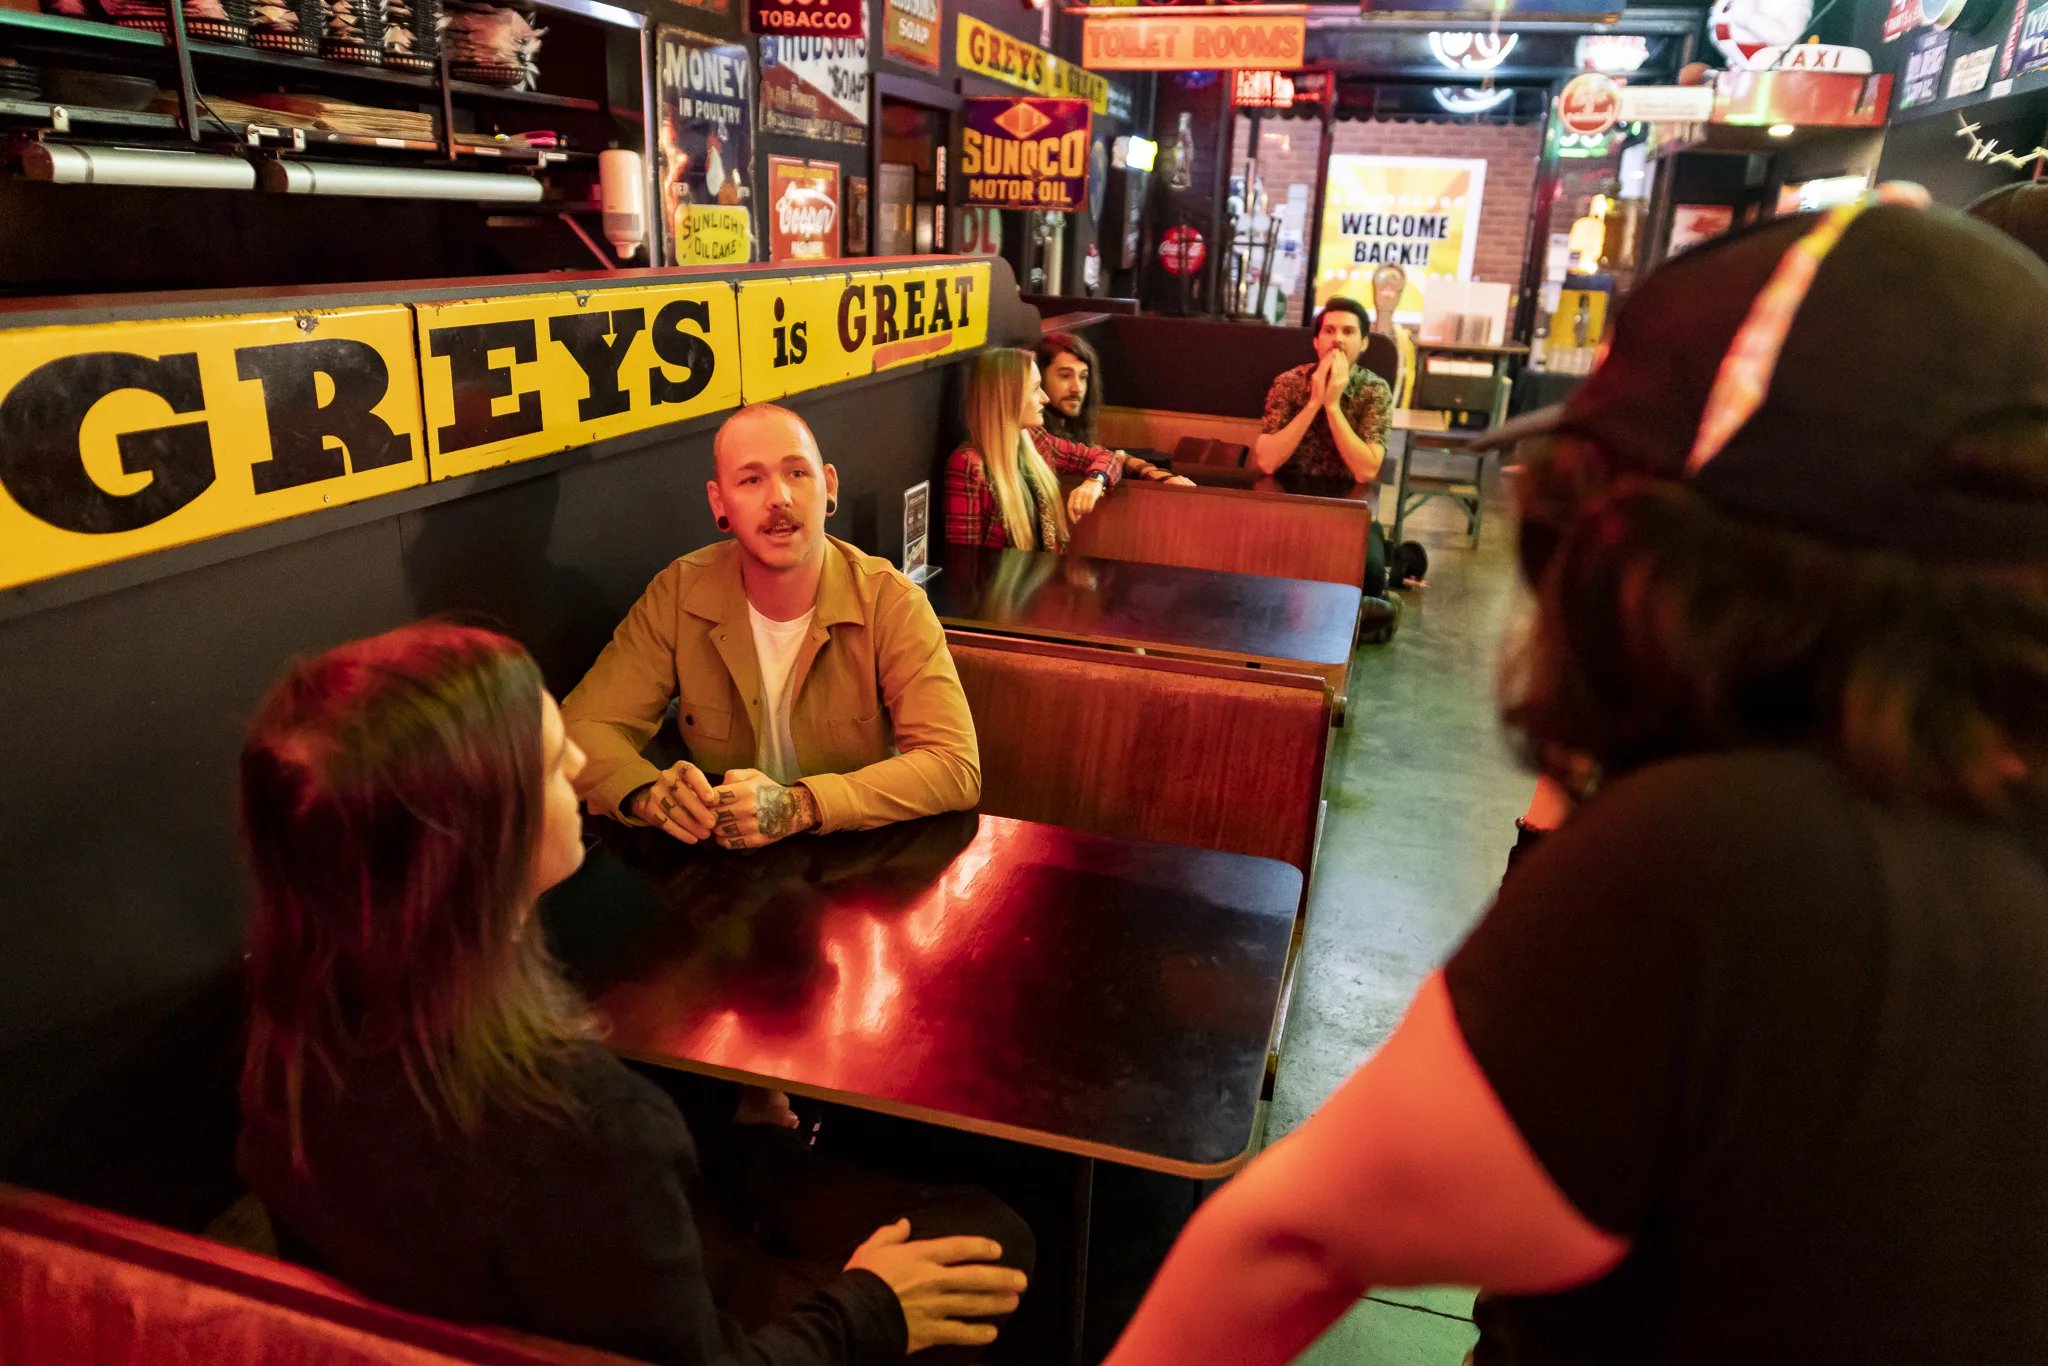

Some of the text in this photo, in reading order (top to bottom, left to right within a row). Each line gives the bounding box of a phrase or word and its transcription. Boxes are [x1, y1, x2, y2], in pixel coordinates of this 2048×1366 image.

[759, 10, 852, 29] TOBACCO
[899, 17, 931, 45] SOAP
[1087, 26, 1299, 58] TOILET ROOMS
[665, 41, 749, 100] MONEY
[1778, 49, 1841, 68] TAXI
[679, 97, 741, 125] IN POULTRY
[961, 127, 1086, 177] SUNOCO
[969, 178, 1072, 203] MOTOR OIL
[1341, 212, 1449, 239] WELCOME
[1354, 241, 1430, 265] BACK!!
[0, 276, 974, 534] GREYS is GREAT
